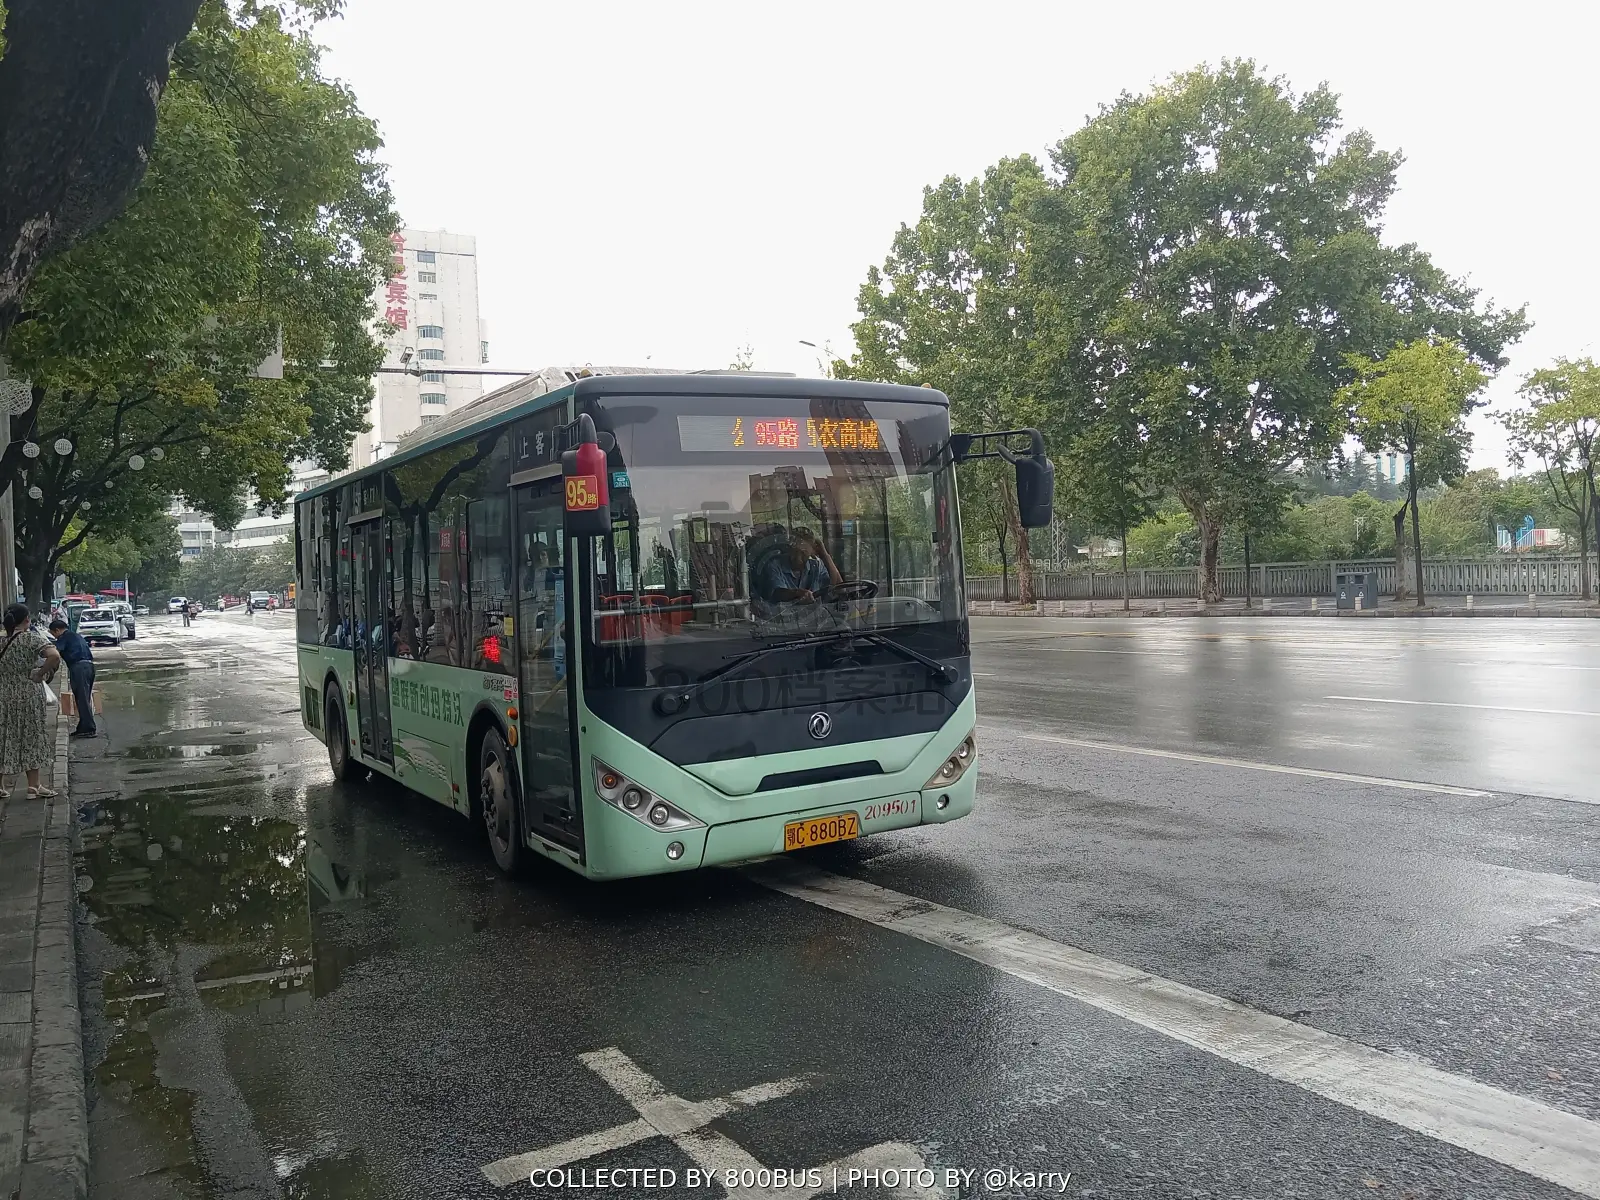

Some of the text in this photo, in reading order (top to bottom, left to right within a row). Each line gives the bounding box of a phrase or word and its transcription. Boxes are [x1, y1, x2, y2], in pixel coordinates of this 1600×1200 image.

[385, 231, 408, 330] 宾馆
[755, 419, 799, 449] 95路
[566, 479, 598, 507] 95路
[864, 799, 916, 820] 209501
